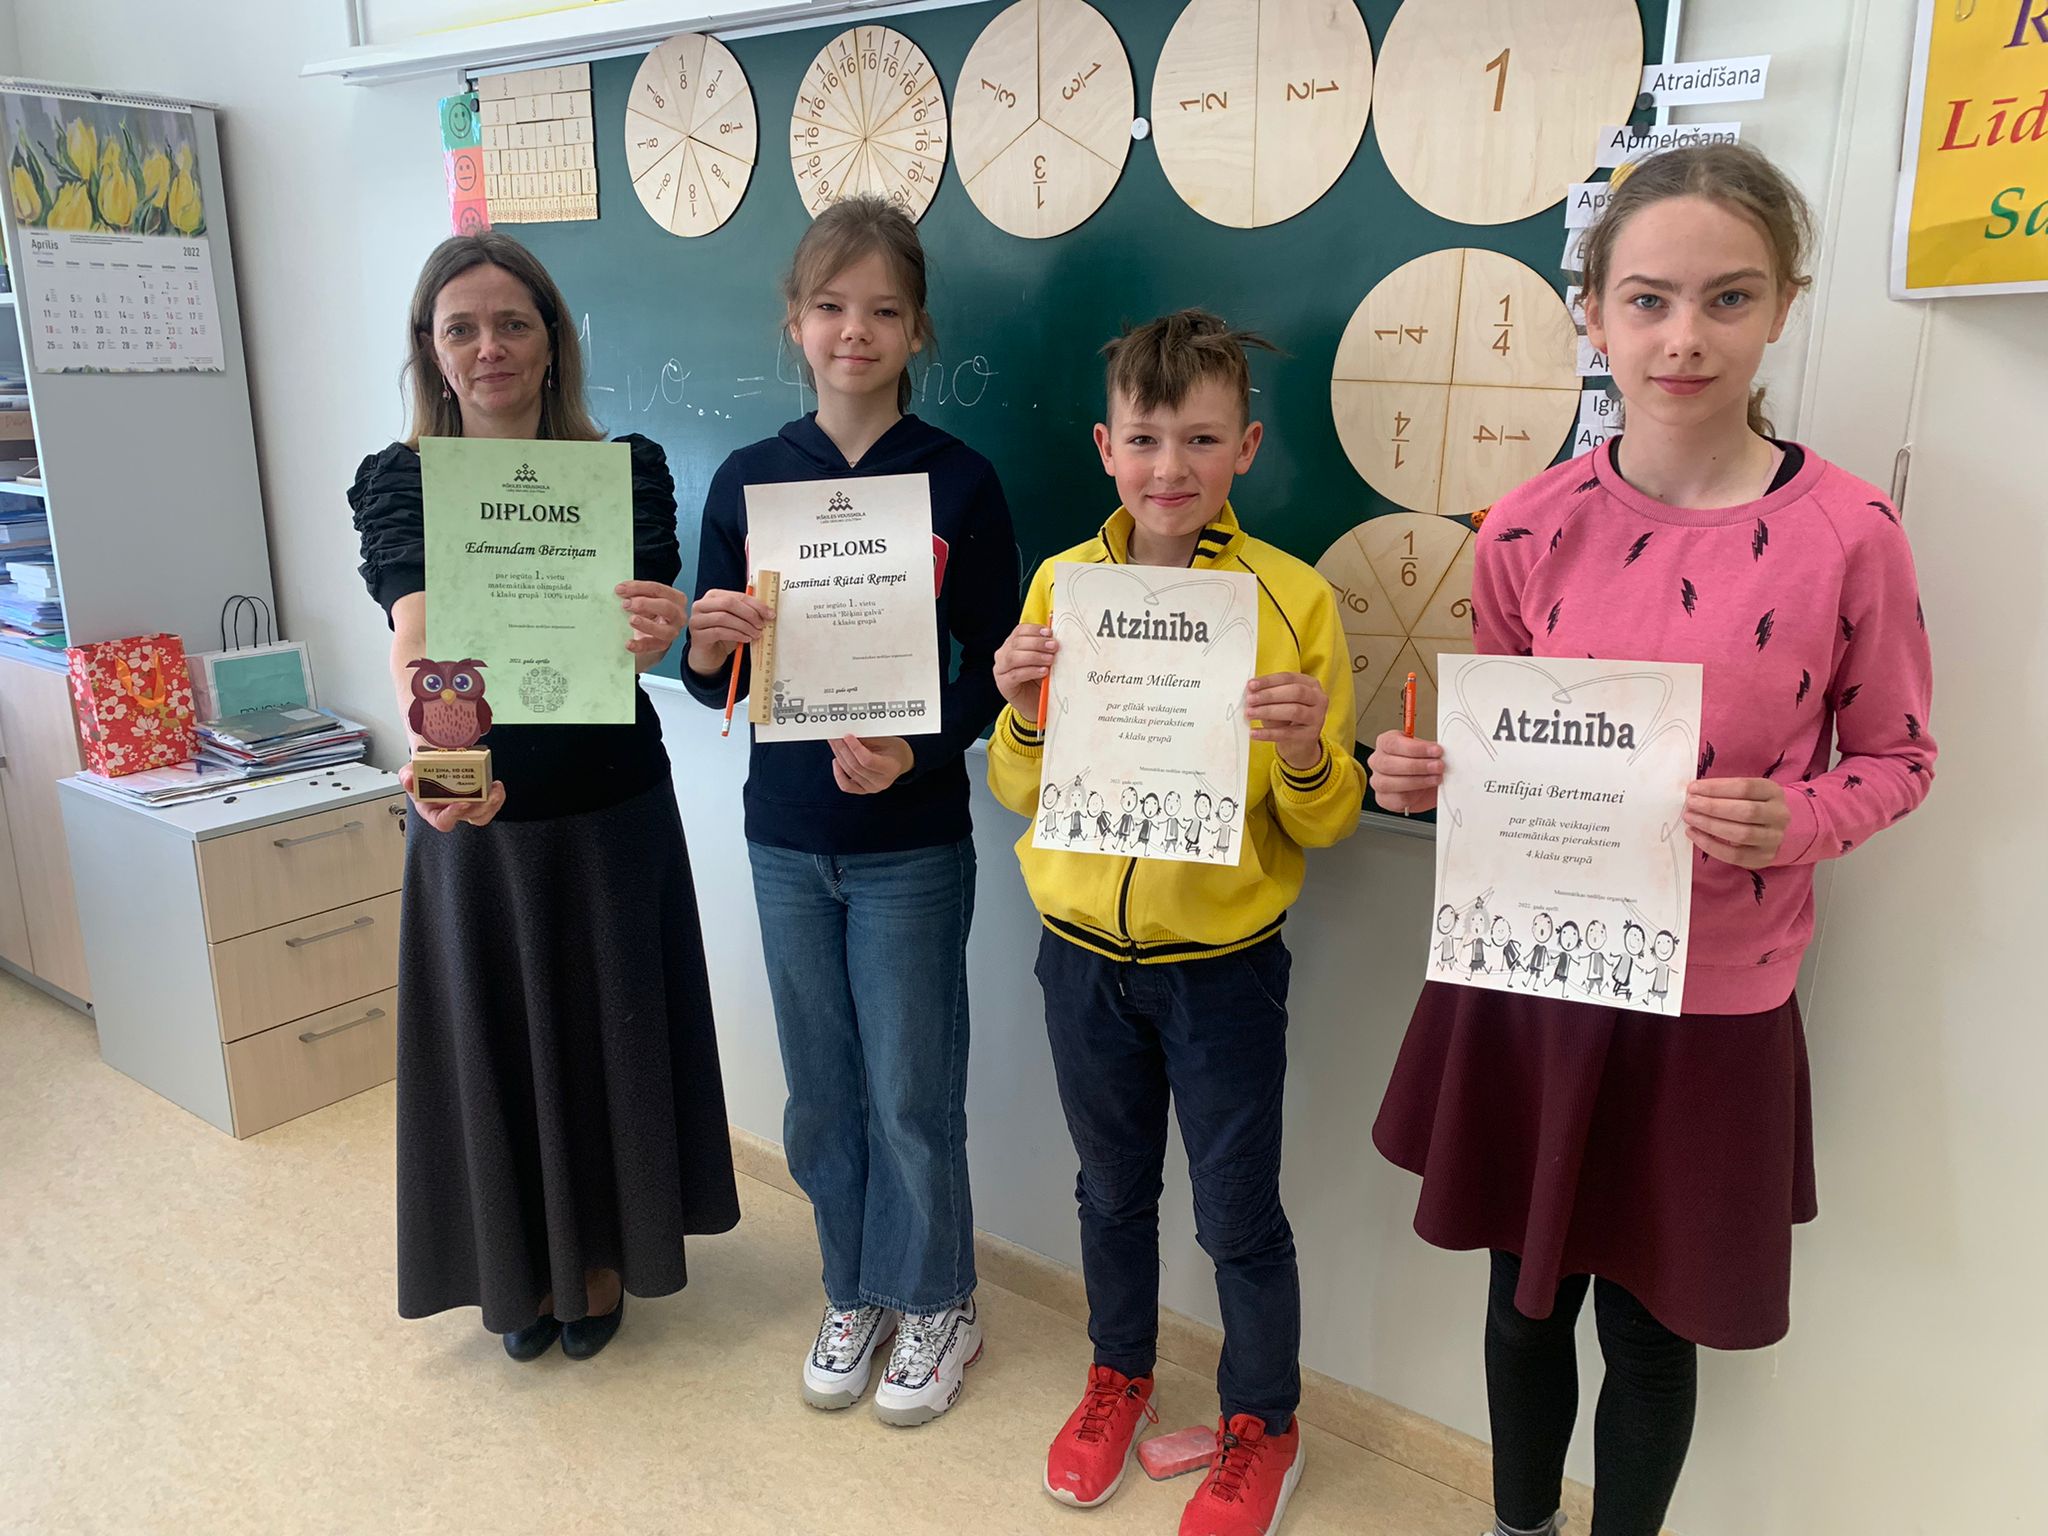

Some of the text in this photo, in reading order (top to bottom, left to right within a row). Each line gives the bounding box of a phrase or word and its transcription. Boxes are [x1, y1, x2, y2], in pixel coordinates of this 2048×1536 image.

[1485, 47, 1511, 112] 1
[1652, 64, 1761, 93] Atraidīšana
[183, 247, 200, 257] 2022
[480, 502, 581, 524] DIPLOMS
[465, 541, 597, 559] Edmundam Bērziņam
[799, 538, 887, 560] DIPLOMS
[535, 570, 544, 580] 1.
[781, 570, 907, 591] Jasmīnai Rūtai Rempei
[849, 598, 857, 607] 1.
[1096, 608, 1209, 644] Atzinība
[1086, 670, 1201, 689] Robertam Milleram
[1106, 703, 1121, 713] par
[1147, 703, 1187, 715] veiktajiem
[1098, 715, 1195, 729] matemātikas pierakstiem
[1492, 706, 1636, 749] Atzinība
[1147, 734, 1172, 745] grupā
[1483, 779, 1625, 804] Emīlijai Bertmanei
[1508, 815, 1610, 833] par glītāk veiktajiem
[1499, 829, 1621, 849] matemātikas pierakstiem
[1562, 853, 1593, 866] grupā
[947, 1380, 962, 1405] FILA
